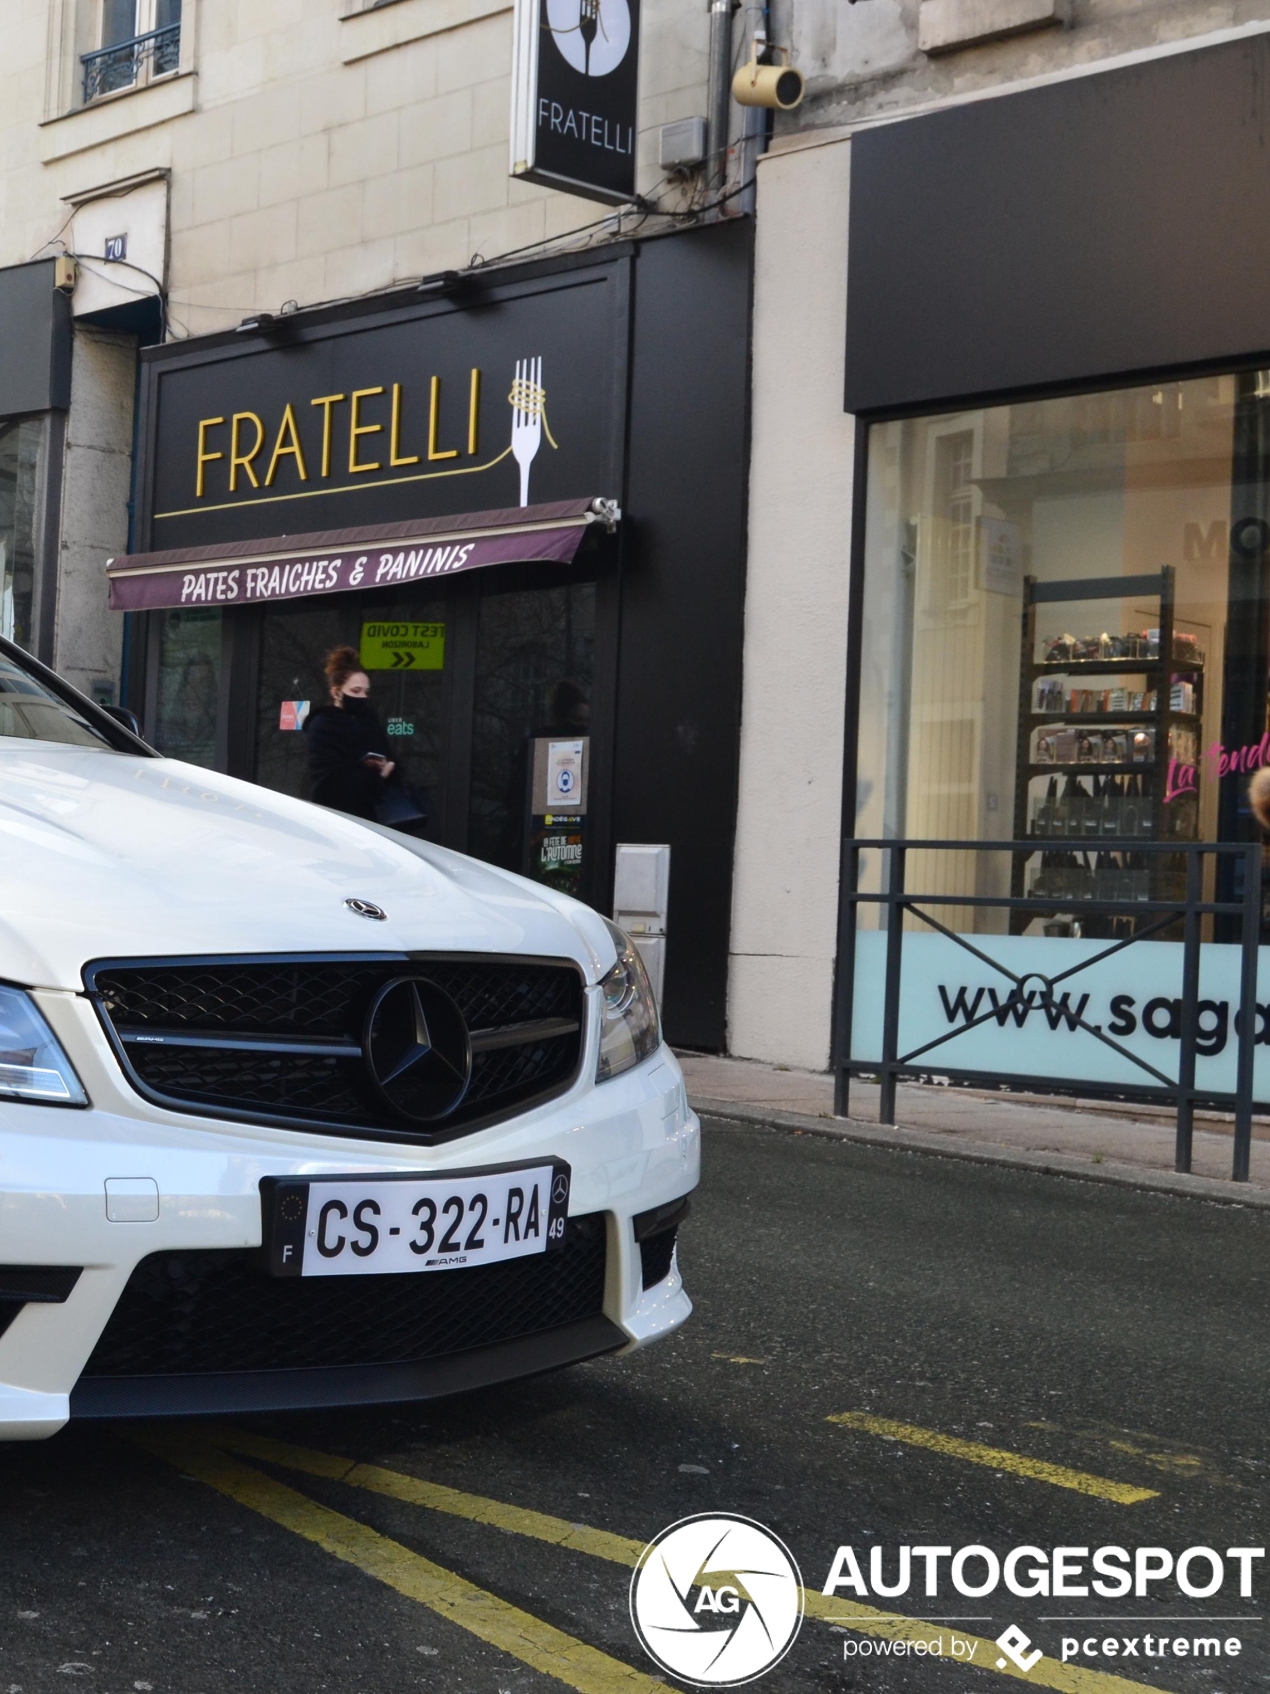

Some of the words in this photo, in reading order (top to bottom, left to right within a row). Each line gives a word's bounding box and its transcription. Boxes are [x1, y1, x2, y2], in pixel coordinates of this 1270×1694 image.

[538, 98, 632, 154] FRATELLI
[108, 238, 122, 259] 70
[196, 369, 481, 497] FRATELLI
[182, 575, 239, 602] PATES
[246, 559, 342, 595] FRAICHES
[349, 557, 366, 582] &
[375, 544, 475, 583] PANINIS
[387, 722, 414, 735] eats
[1163, 757, 1197, 803] La
[1199, 732, 1270, 782] tend
[316, 1184, 540, 1258] CS-322-RA
[548, 1217, 565, 1239] 49
[282, 1245, 293, 1263] F
[438, 1256, 468, 1265] AMG
